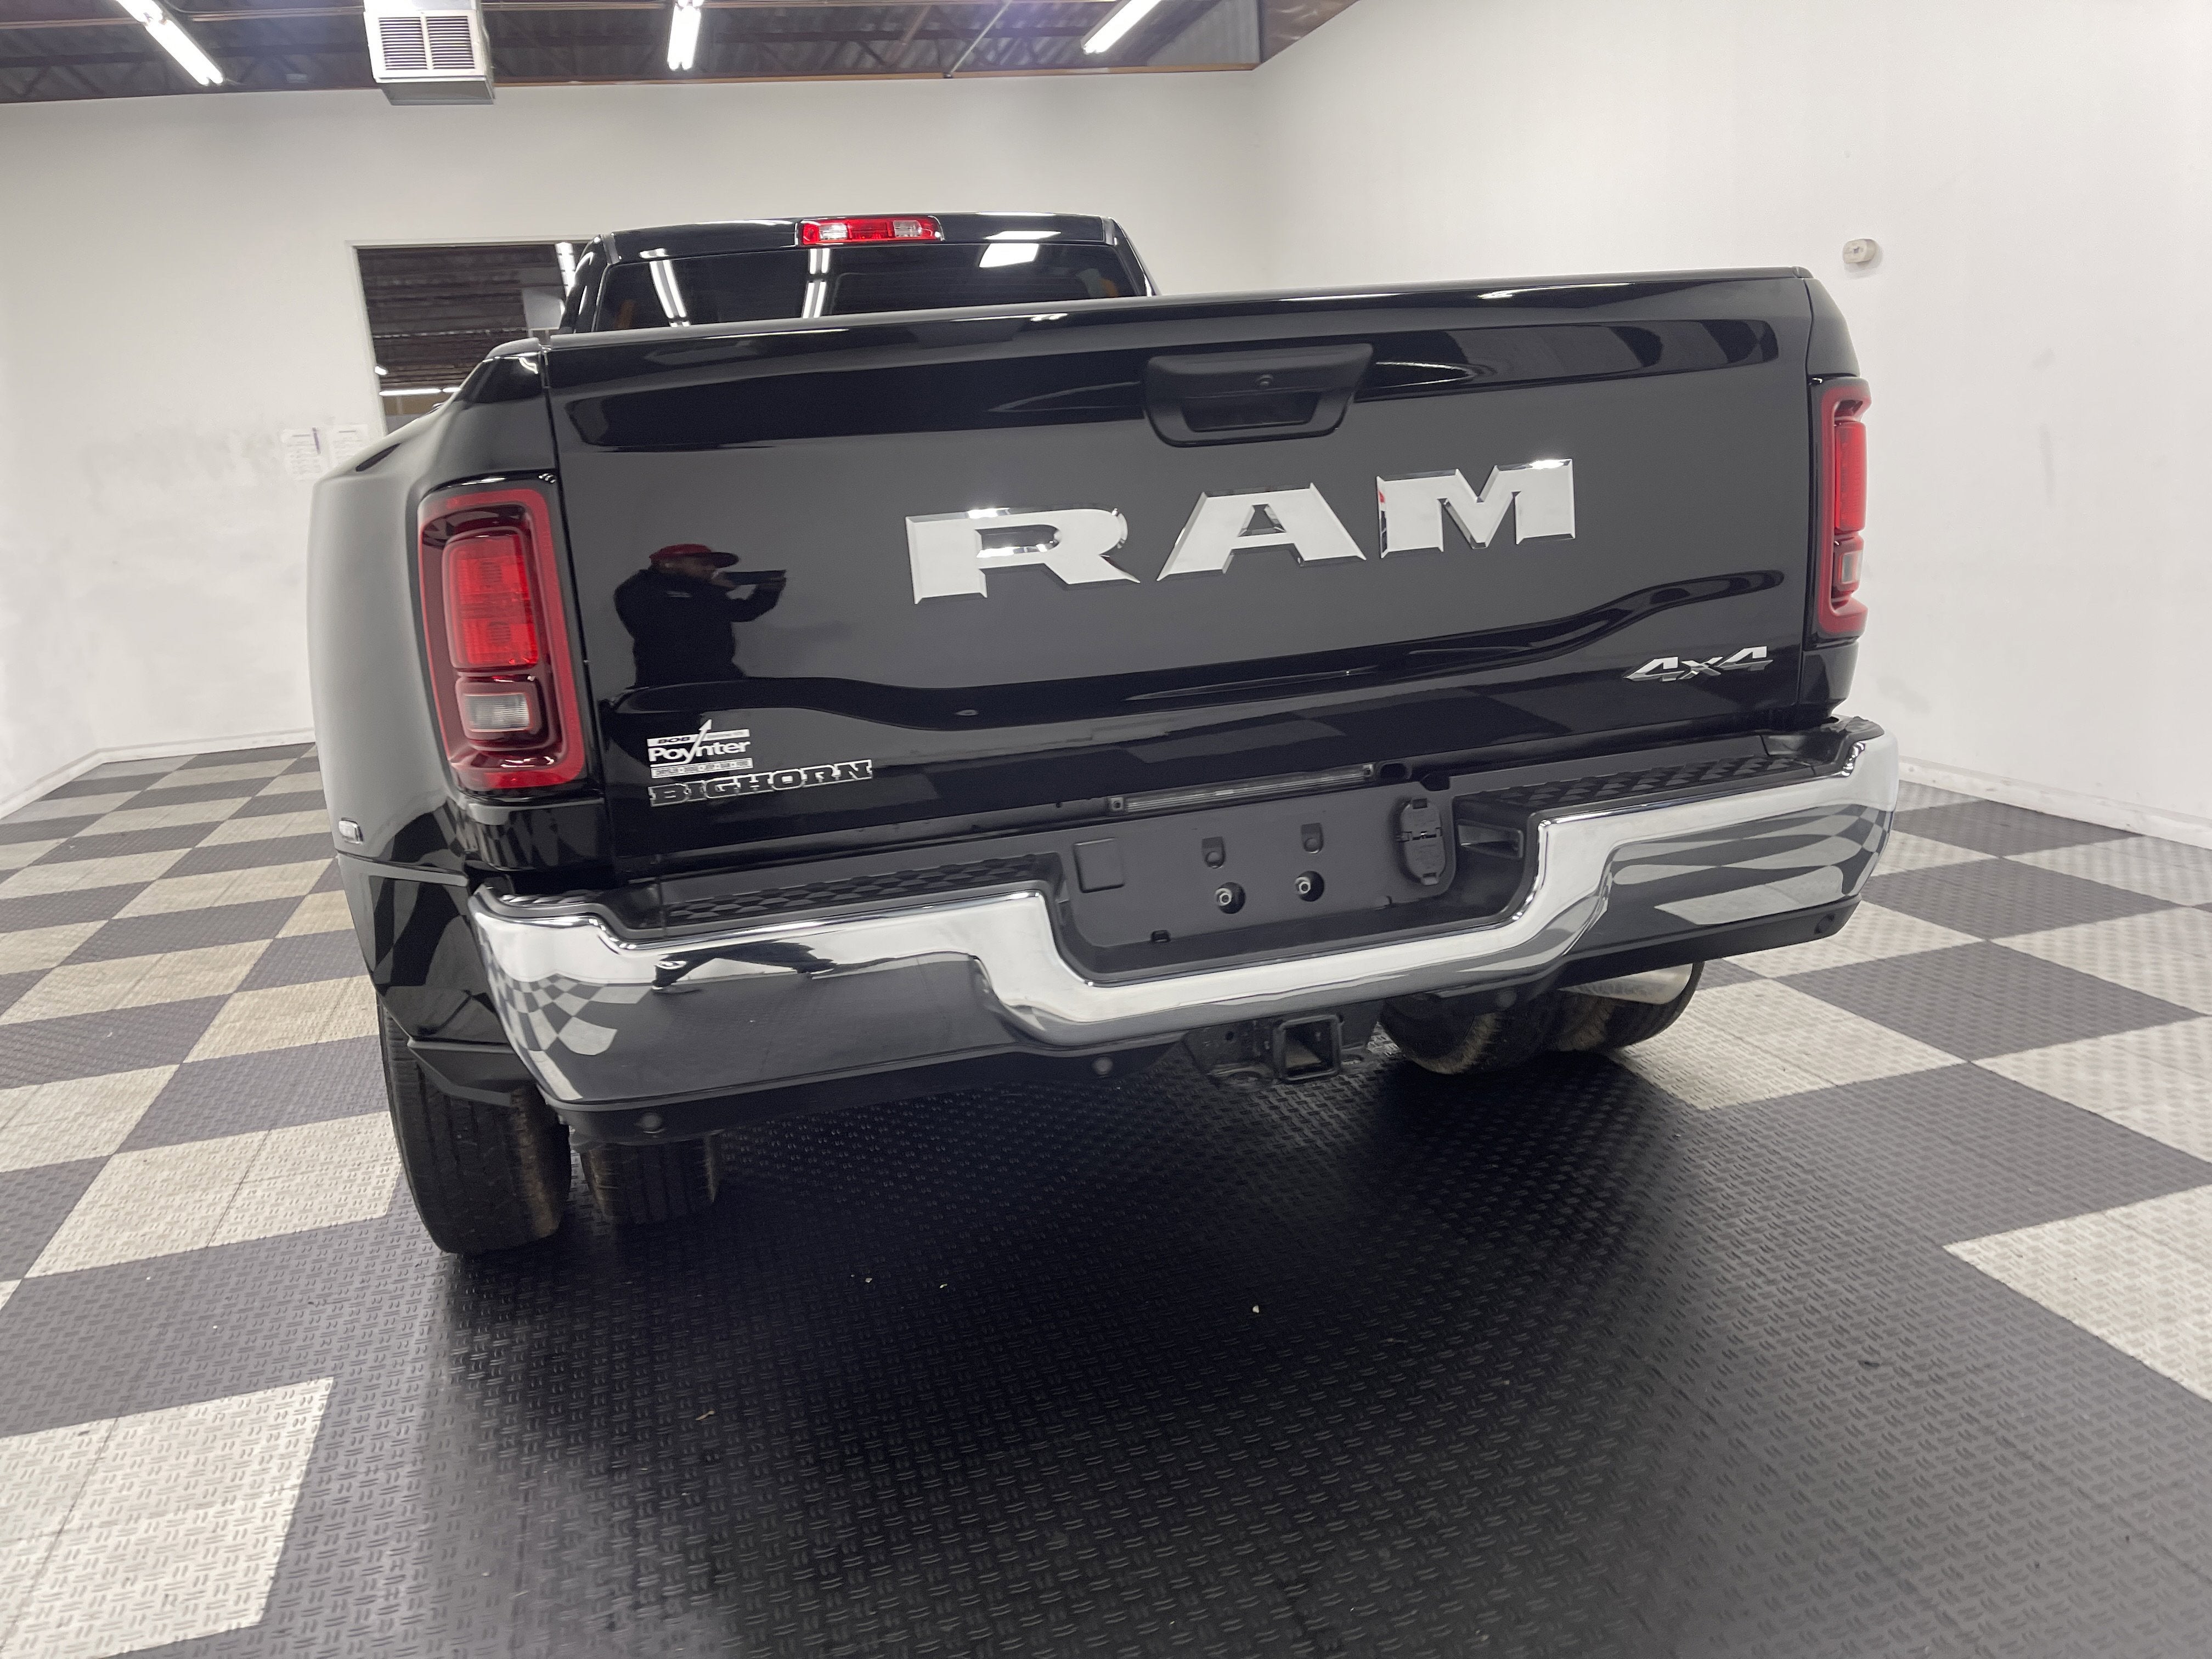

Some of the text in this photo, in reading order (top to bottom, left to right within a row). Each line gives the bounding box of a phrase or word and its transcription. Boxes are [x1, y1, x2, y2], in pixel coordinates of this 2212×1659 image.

[906, 459, 1575, 604] RAM
[1626, 646, 1773, 682] 4x4
[648, 741, 751, 764] Poynter
[648, 759, 872, 806] BIGHORN
